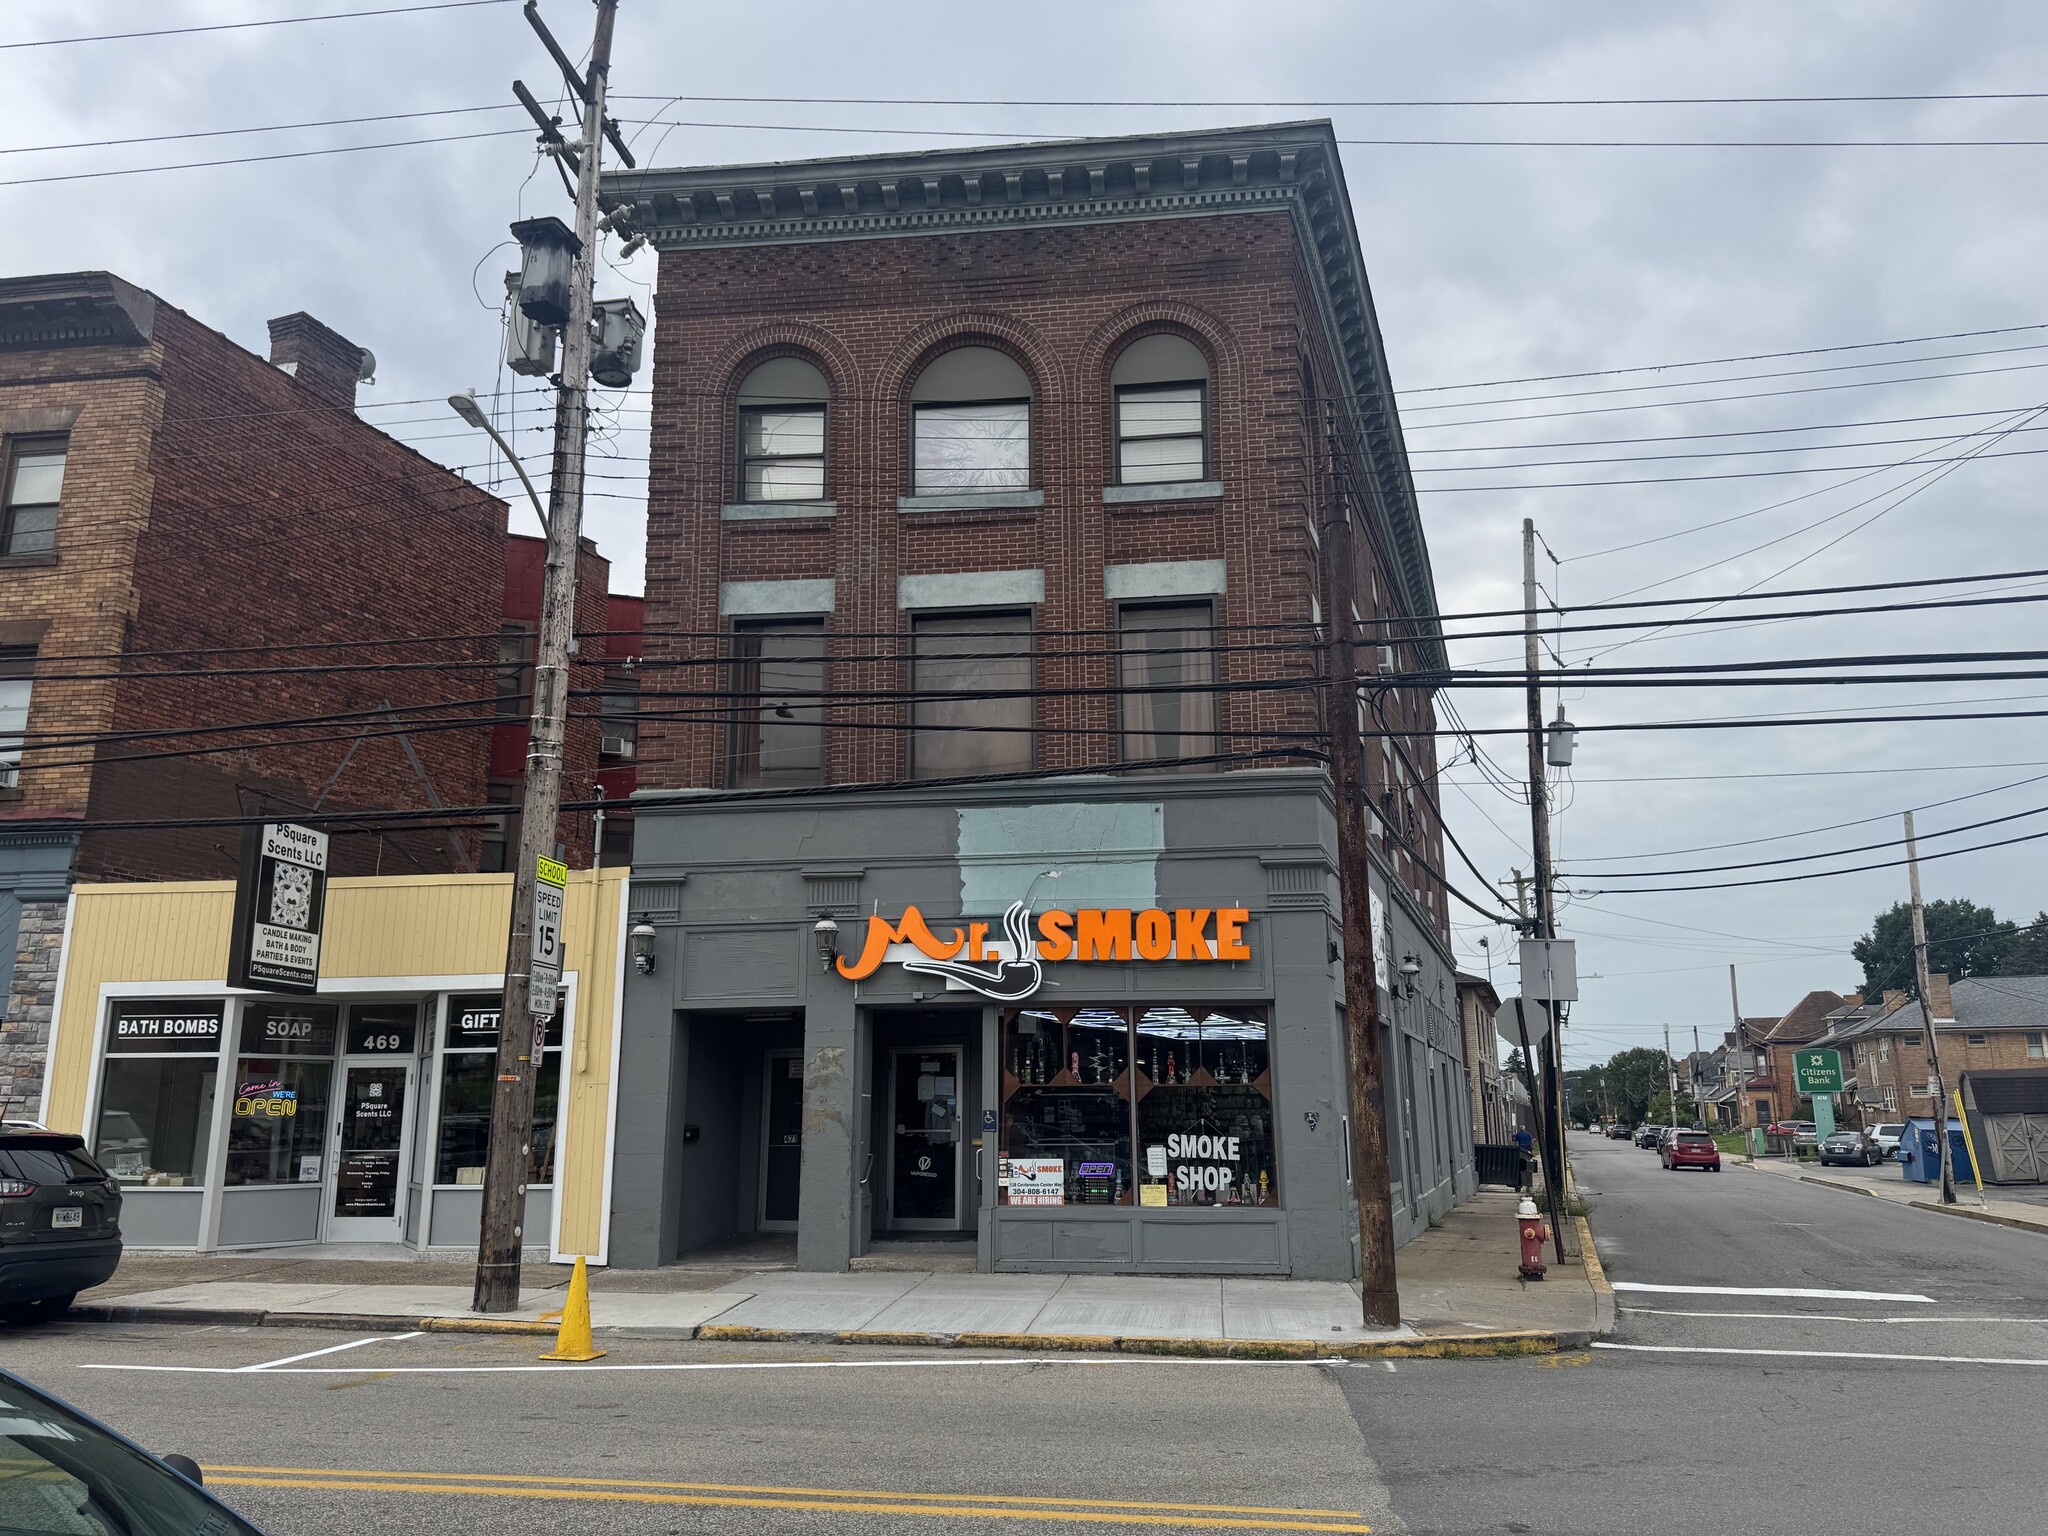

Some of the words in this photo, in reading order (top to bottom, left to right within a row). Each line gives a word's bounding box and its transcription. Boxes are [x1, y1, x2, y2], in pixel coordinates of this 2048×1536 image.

[276, 823, 317, 847] PSquare
[267, 839, 303, 861] Scents
[304, 852, 323, 866] LLC
[539, 861, 565, 882] SCHOOL
[537, 891, 561, 908] SPEED
[539, 908, 558, 924] LIMIT
[262, 927, 288, 940] CANDLE
[289, 933, 312, 944] MAKING
[539, 924, 555, 956] 15
[836, 905, 999, 981] Mr.
[1036, 908, 1251, 962] SMOKE
[265, 939, 283, 950] BATH
[284, 942, 289, 951] &
[290, 944, 307, 954] BODY
[256, 949, 283, 962] PARTIES
[284, 953, 289, 962] &
[290, 955, 313, 966] EVENTS
[252, 963, 314, 981] PSquareScents.com
[118, 1019, 159, 1035] BATH
[163, 1018, 219, 1035] BOMBS
[266, 1021, 312, 1037] SOAP
[461, 1013, 501, 1029] GIFT
[364, 1035, 400, 1050] 469
[1801, 1068, 1836, 1076] Citizens
[1808, 1076, 1830, 1084] Bank
[239, 1082, 267, 1096] Come
[268, 1079, 282, 1089] in
[272, 1090, 296, 1099] WE'RE
[235, 1097, 297, 1116] OPEN
[355, 1110, 378, 1118] Scents
[379, 1110, 392, 1118] LLC
[360, 1102, 388, 1110] PSquare
[1167, 1133, 1241, 1161] SMOKE
[1036, 1165, 1063, 1173] SMOKE
[1082, 1165, 1111, 1173] OPEN
[1176, 1165, 1233, 1191] SHOP
[68, 1189, 85, 1198] Jeep
[1010, 1196, 1022, 1205] WE
[1022, 1196, 1037, 1205] ARE
[1037, 1196, 1063, 1205] HIRING
